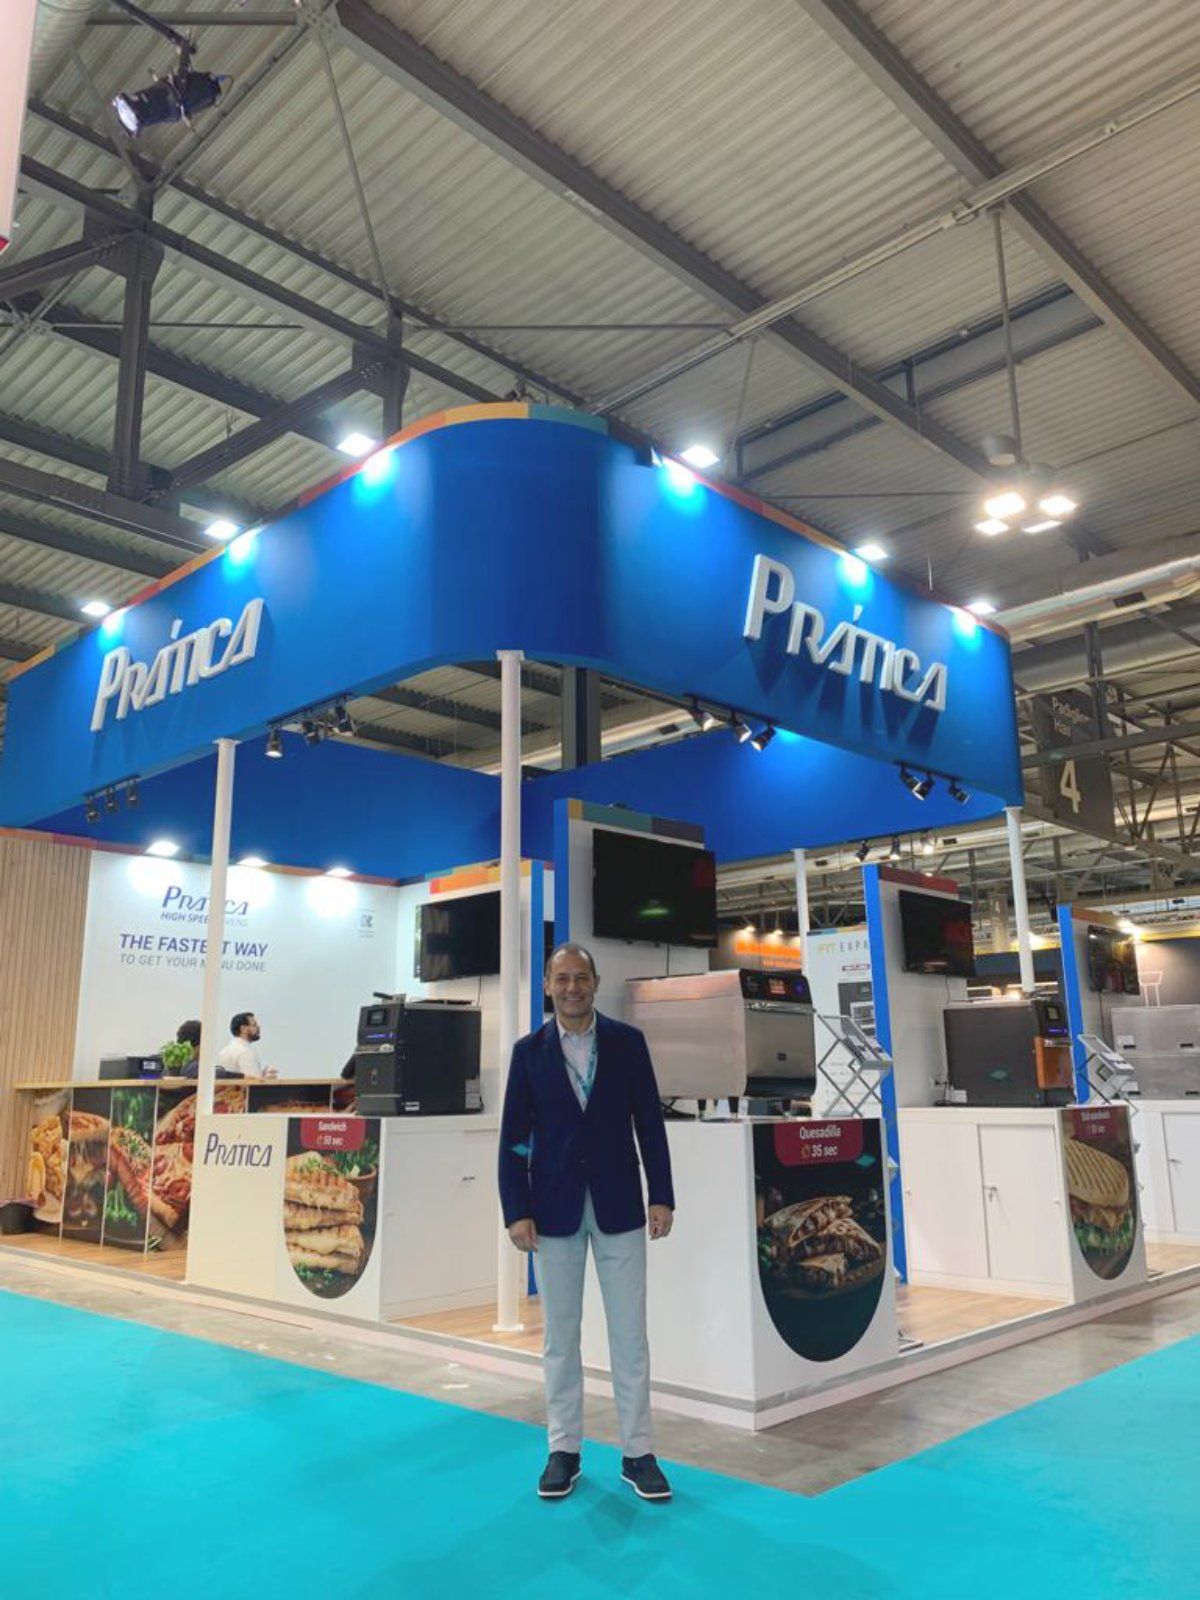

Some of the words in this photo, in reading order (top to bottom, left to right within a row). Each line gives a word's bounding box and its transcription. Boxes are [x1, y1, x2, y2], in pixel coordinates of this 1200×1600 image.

[1060, 760, 1081, 813] 4
[161, 911, 185, 921] HIGH
[188, 913, 210, 924] SPEE
[120, 933, 154, 950] THE
[158, 936, 230, 954] FASTET
[235, 942, 268, 957] WAY
[120, 953, 135, 964] TO
[138, 954, 163, 966] GET
[167, 956, 195, 967] YOUR
[235, 961, 268, 972] DONE
[800, 1125, 841, 1140] Quesadilla
[811, 1144, 822, 1157] 35
[824, 1145, 838, 1156] sec
